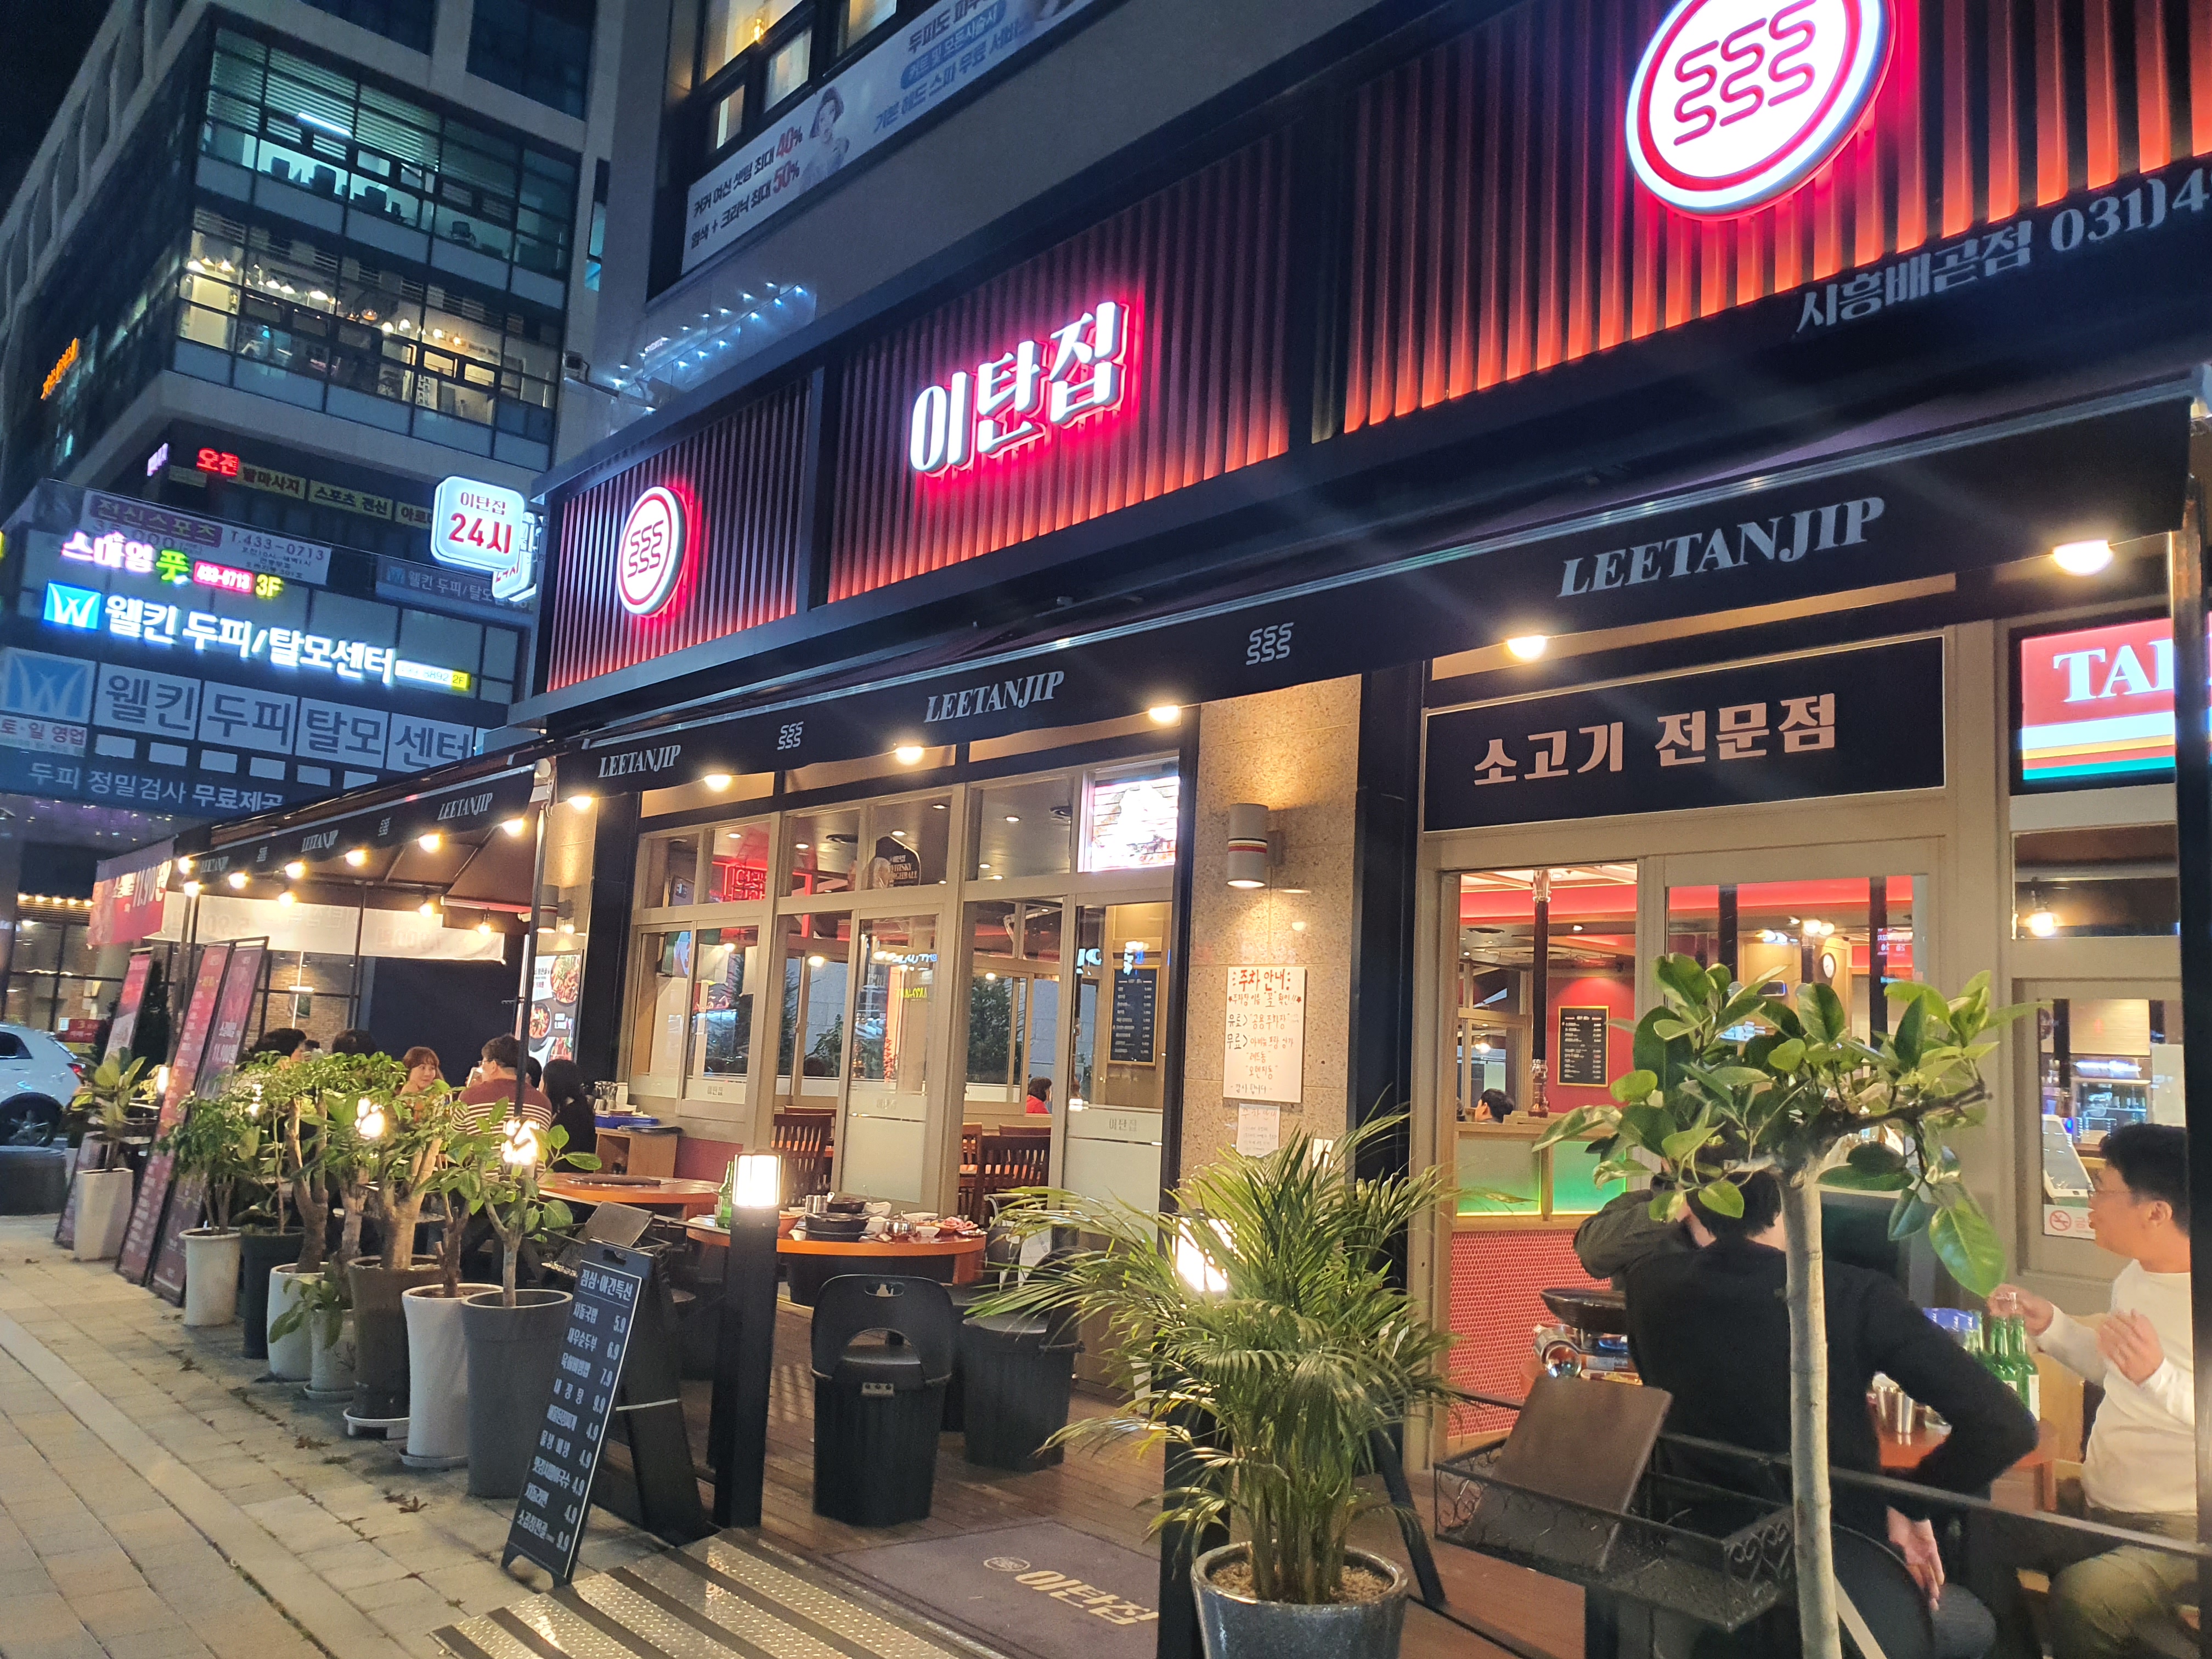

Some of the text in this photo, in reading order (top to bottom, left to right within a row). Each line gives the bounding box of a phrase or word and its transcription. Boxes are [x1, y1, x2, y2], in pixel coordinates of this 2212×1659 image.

[754, 146, 775, 175] 최대
[776, 126, 803, 158] 40%
[751, 180, 771, 208] 최대
[772, 160, 800, 194] 50%
[1796, 168, 2212, 333] 시흥배곧점 031)4
[910, 301, 1127, 473] 이탄집
[314, 485, 357, 506] 스포츠
[460, 492, 506, 516] 이탄집
[98, 499, 216, 544] 전신스포츠
[448, 512, 512, 554] 24시
[61, 531, 155, 572] 스마일
[156, 549, 190, 584] 풋
[255, 574, 284, 597] 3F
[1558, 496, 1886, 598] LEETANJIP
[106, 595, 178, 645] 웰킨
[182, 610, 396, 685] 두피/탈모센터
[452, 674, 465, 685] 2F
[924, 670, 1064, 723] LEETANJIP
[106, 675, 195, 731] 웰킨
[207, 693, 291, 747] 두피
[306, 708, 382, 755] 탈모
[394, 725, 471, 768] 센터
[1474, 693, 1837, 787] 소고기 전문점
[598, 744, 681, 778] LEETANJIP
[28, 763, 80, 790] 두피
[87, 770, 187, 804] 정밀검사
[438, 792, 493, 821] LEETANJIP
[1238, 968, 1285, 992] 주차 안내
[1232, 994, 1249, 1007] 주차장
[613, 1315, 627, 1334] 5.9
[607, 1341, 620, 1361] 6.9
[600, 1368, 613, 1387] 7.9
[592, 1395, 606, 1414] 9.9
[586, 1422, 599, 1442] 4.9
[579, 1449, 592, 1469] 4.9
[572, 1476, 585, 1497] 4.9
[564, 1504, 578, 1525] 4.9
[556, 1531, 570, 1552] 9.9
[1015, 1570, 1159, 1625] 이탄집
